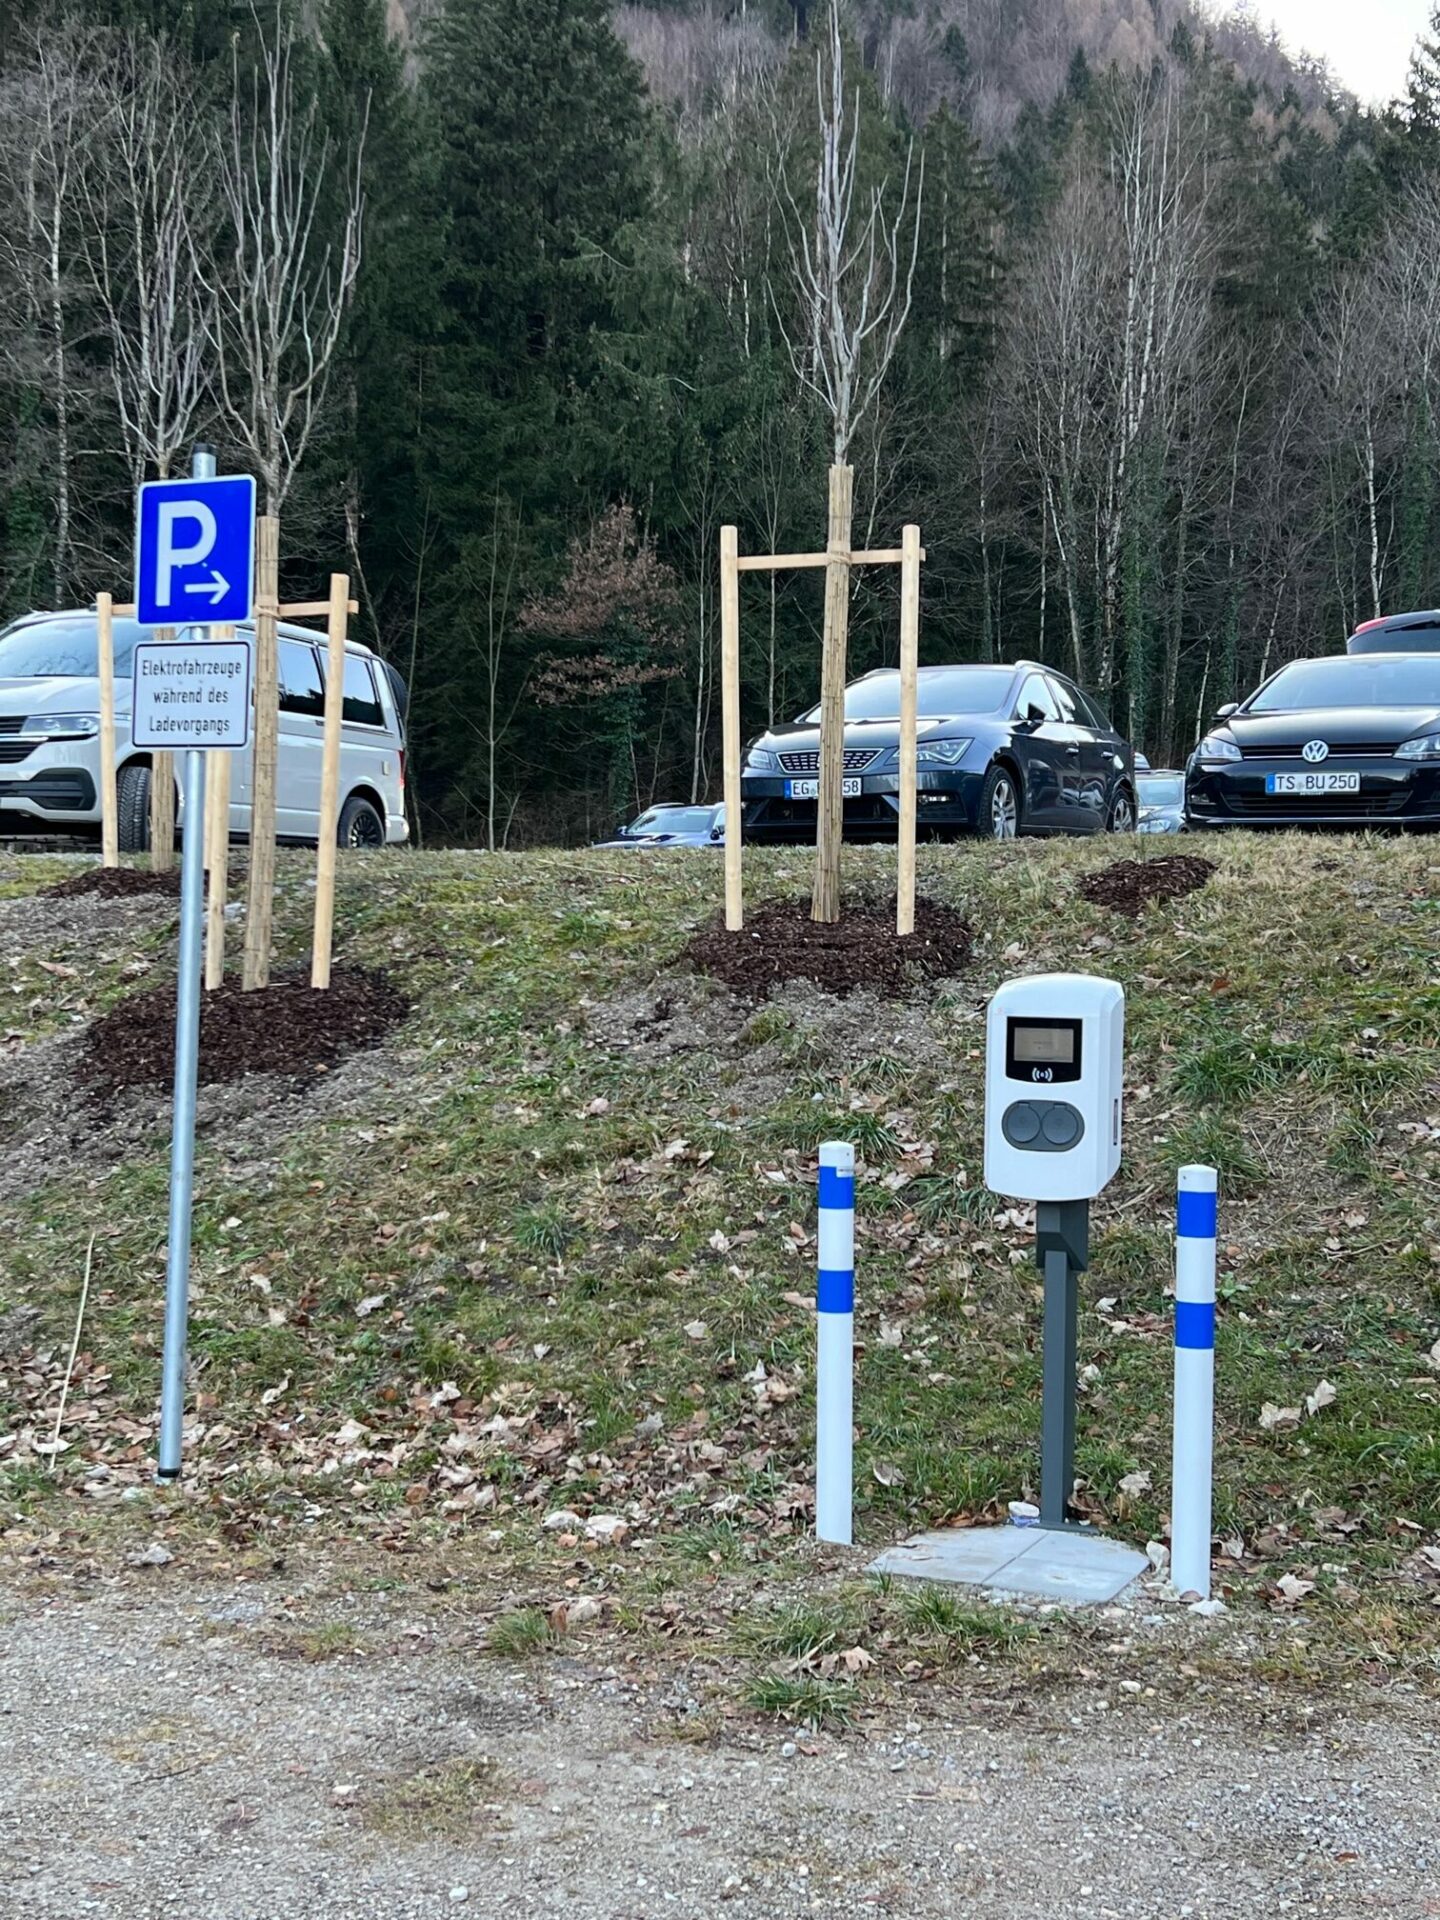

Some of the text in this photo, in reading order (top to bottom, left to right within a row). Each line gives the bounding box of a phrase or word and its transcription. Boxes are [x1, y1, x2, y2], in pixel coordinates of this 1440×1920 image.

[155, 500, 217, 607] P
[142, 659, 242, 678] Elektrofahrzeuge
[153, 686, 229, 703] während des
[149, 716, 230, 736] Ladevorgangs
[793, 782, 809, 795] EG
[1276, 775, 1357, 790] TS BU 250
